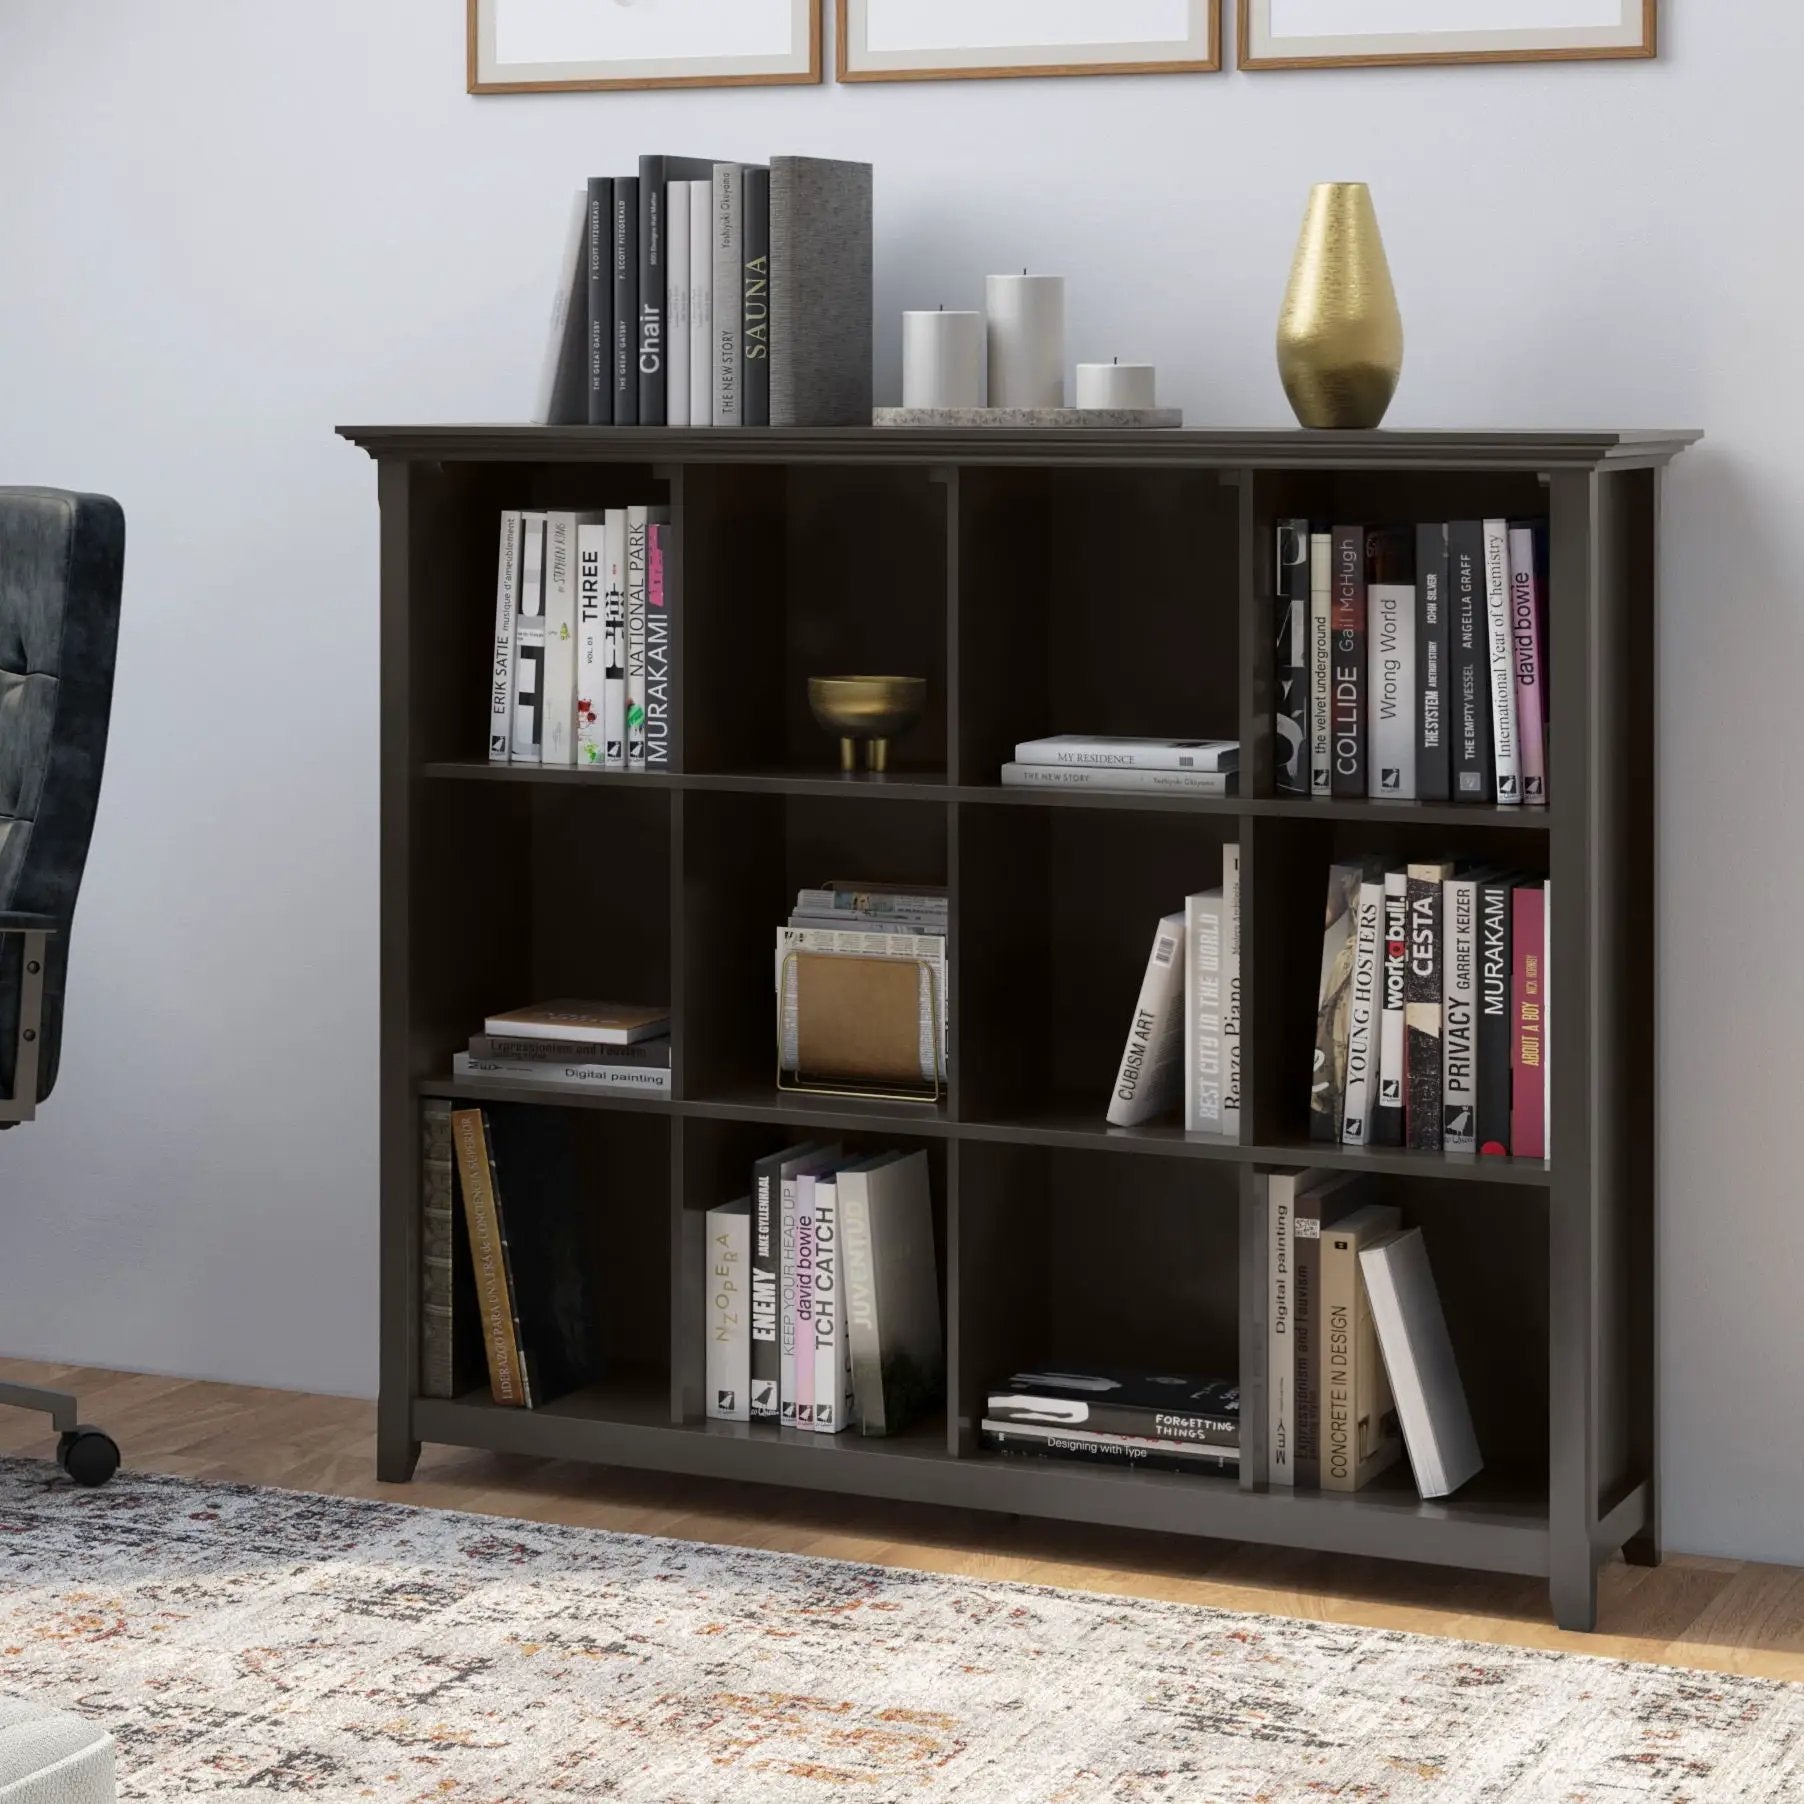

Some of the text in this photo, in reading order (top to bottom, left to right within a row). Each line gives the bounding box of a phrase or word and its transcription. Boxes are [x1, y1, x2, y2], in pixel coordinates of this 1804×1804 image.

[640, 304, 660, 373] Chair
[745, 256, 766, 358] SAUNA
[722, 331, 733, 364] STORY
[722, 366, 733, 390] NEW
[502, 593, 512, 631] musique
[583, 551, 598, 622] THREE
[630, 524, 644, 676] NATIONAL PARK
[1460, 554, 1472, 648] ANGELLA GRAFF
[495, 636, 508, 676] SATIE
[1337, 539, 1357, 775] COLLIDE Gail McHugh
[1380, 600, 1400, 719] Wrong World
[1486, 535, 1511, 758] International Year of Chemistry
[1513, 572, 1535, 685] david bowie
[494, 682, 506, 714] ERIK
[648, 614, 668, 762] MURAKAMI
[1315, 617, 1328, 754] the velvet underground
[1463, 664, 1474, 759] THE EMPTY VESSEL
[1058, 752, 1135, 764] MY RESIDENCE
[1413, 897, 1433, 975] CESTA
[1485, 890, 1503, 1015] MURAKAMI
[1349, 903, 1377, 1084] YOUNG HOSTERS
[1448, 889, 1470, 1092] PRIVACY GARRET KEIZER
[1522, 1002, 1539, 1020] BOY
[565, 1068, 663, 1085] Digital painting
[1118, 1009, 1155, 1101] CUBISM ART
[1522, 1035, 1539, 1066] ABOUT
[784, 1189, 794, 1209] UP
[784, 1215, 794, 1260] HEAD
[753, 1176, 775, 1341] ENEMY JAKE GYLLENHAAL
[784, 1266, 794, 1308] YOUR
[797, 1216, 811, 1320] david bowie
[816, 1208, 833, 1291] CATCH
[1276, 1205, 1287, 1334] Digital painting
[490, 1305, 505, 1334] PARA
[784, 1315, 795, 1356] KEEP
[1156, 1414, 1235, 1431] FORGETTING
[1331, 1306, 1347, 1478] CONCRETE IN DESIGN
[1048, 1437, 1097, 1454] Designing
[1100, 1444, 1122, 1454] with
[1156, 1425, 1205, 1439] THINGS
